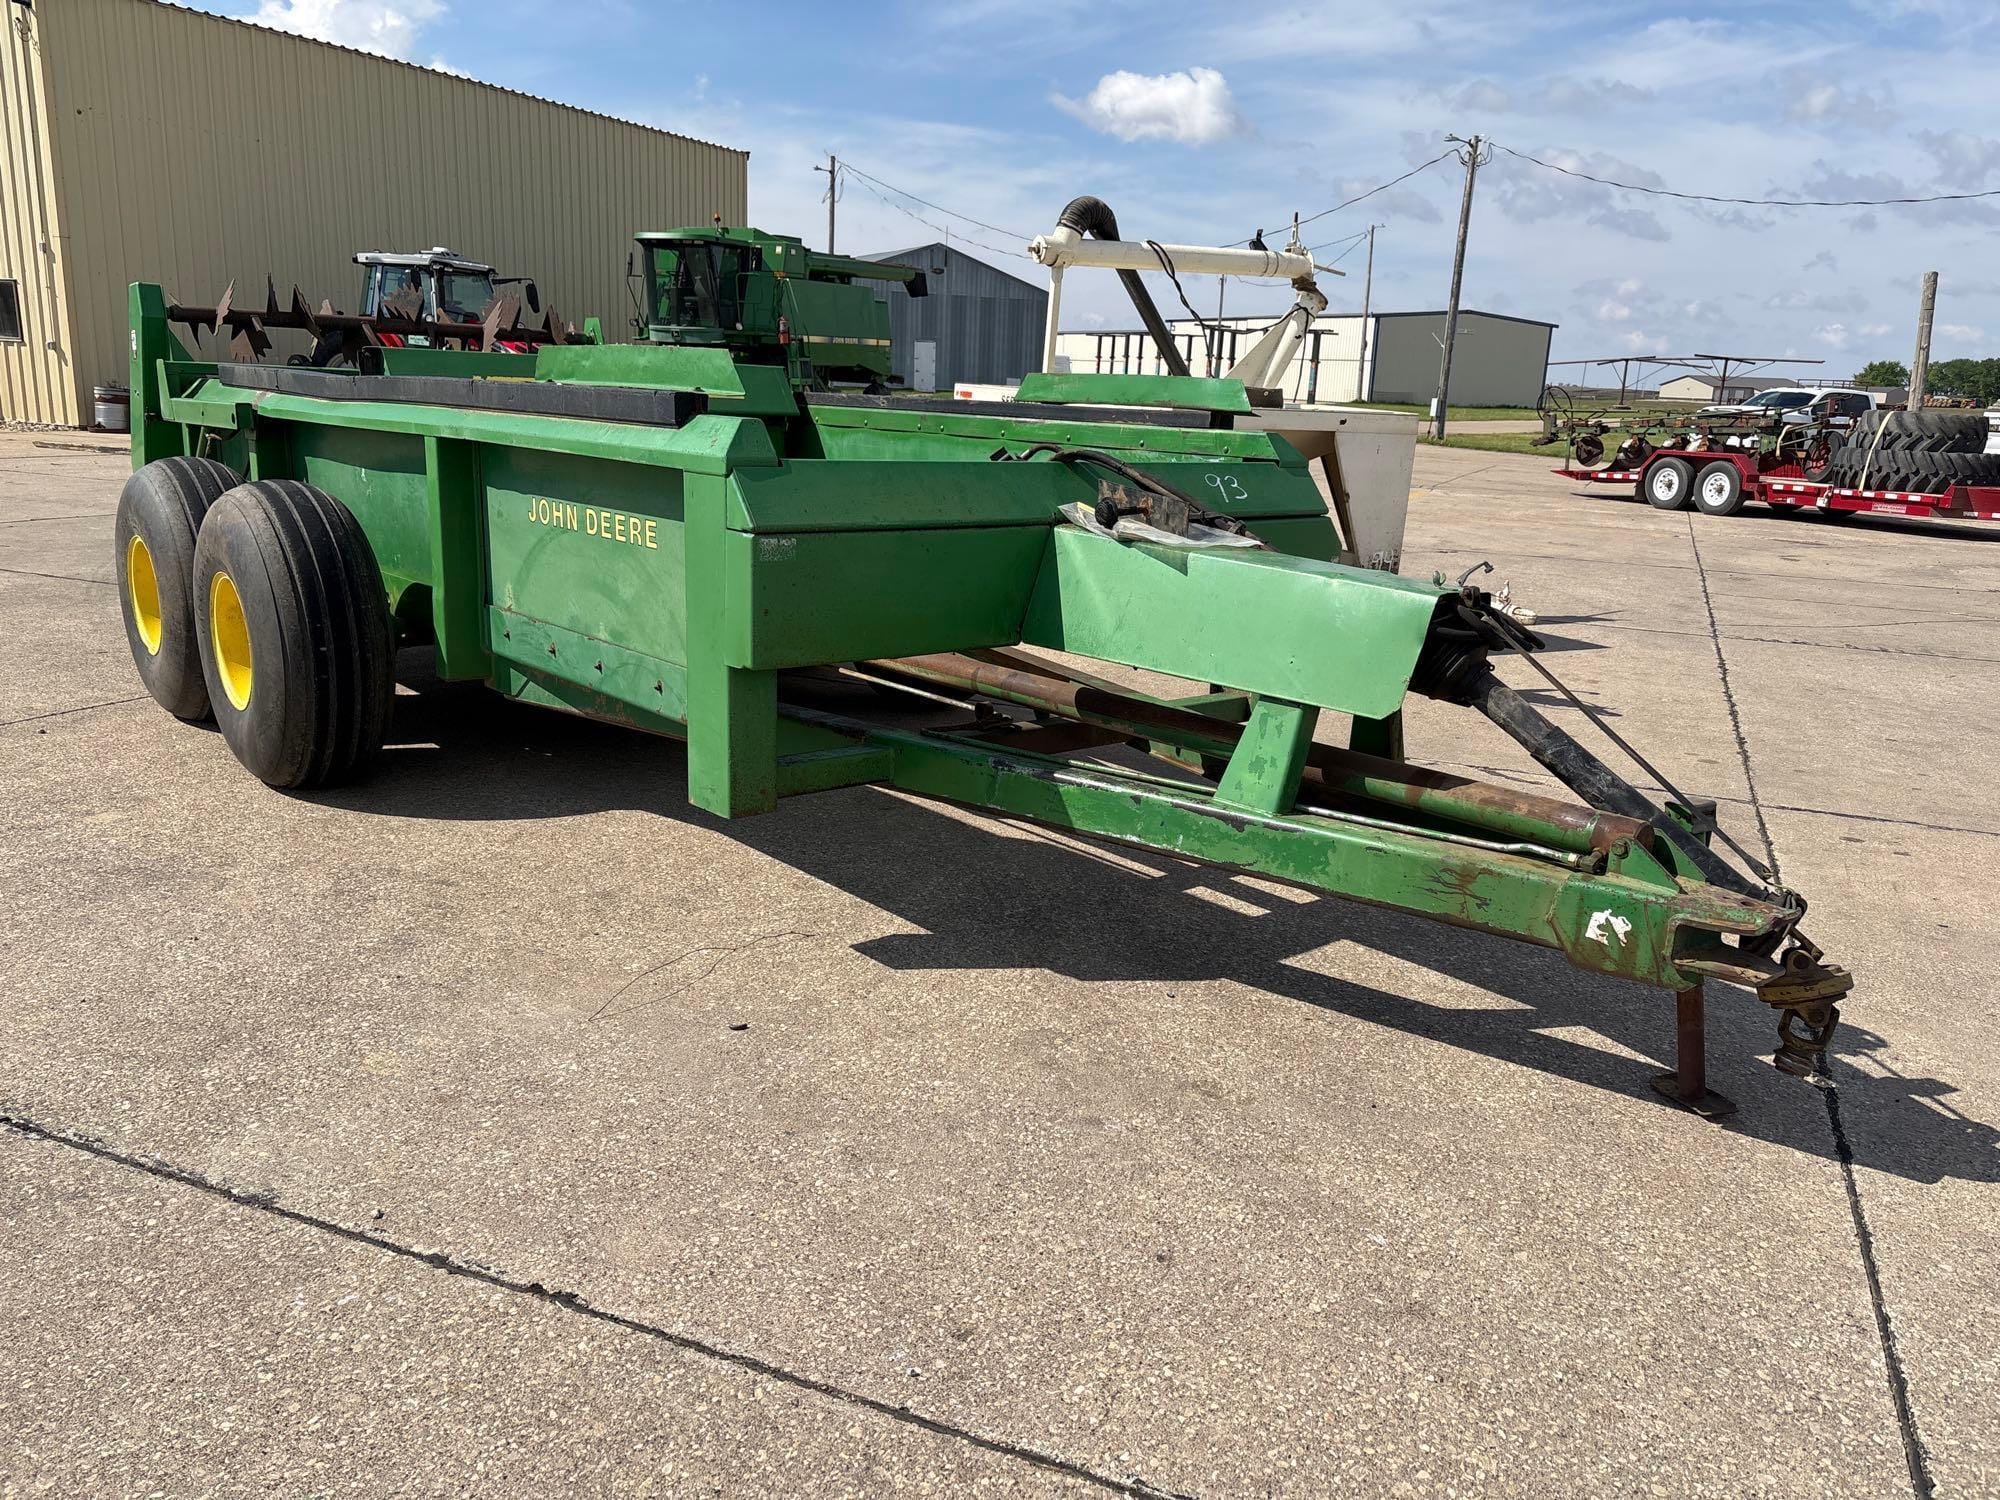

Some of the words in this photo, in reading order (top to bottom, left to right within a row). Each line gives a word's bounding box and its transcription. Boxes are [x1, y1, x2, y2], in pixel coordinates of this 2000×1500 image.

[1204, 473, 1248, 503] 93
[528, 497, 578, 532] JOHN
[585, 507, 658, 550] DEERE
